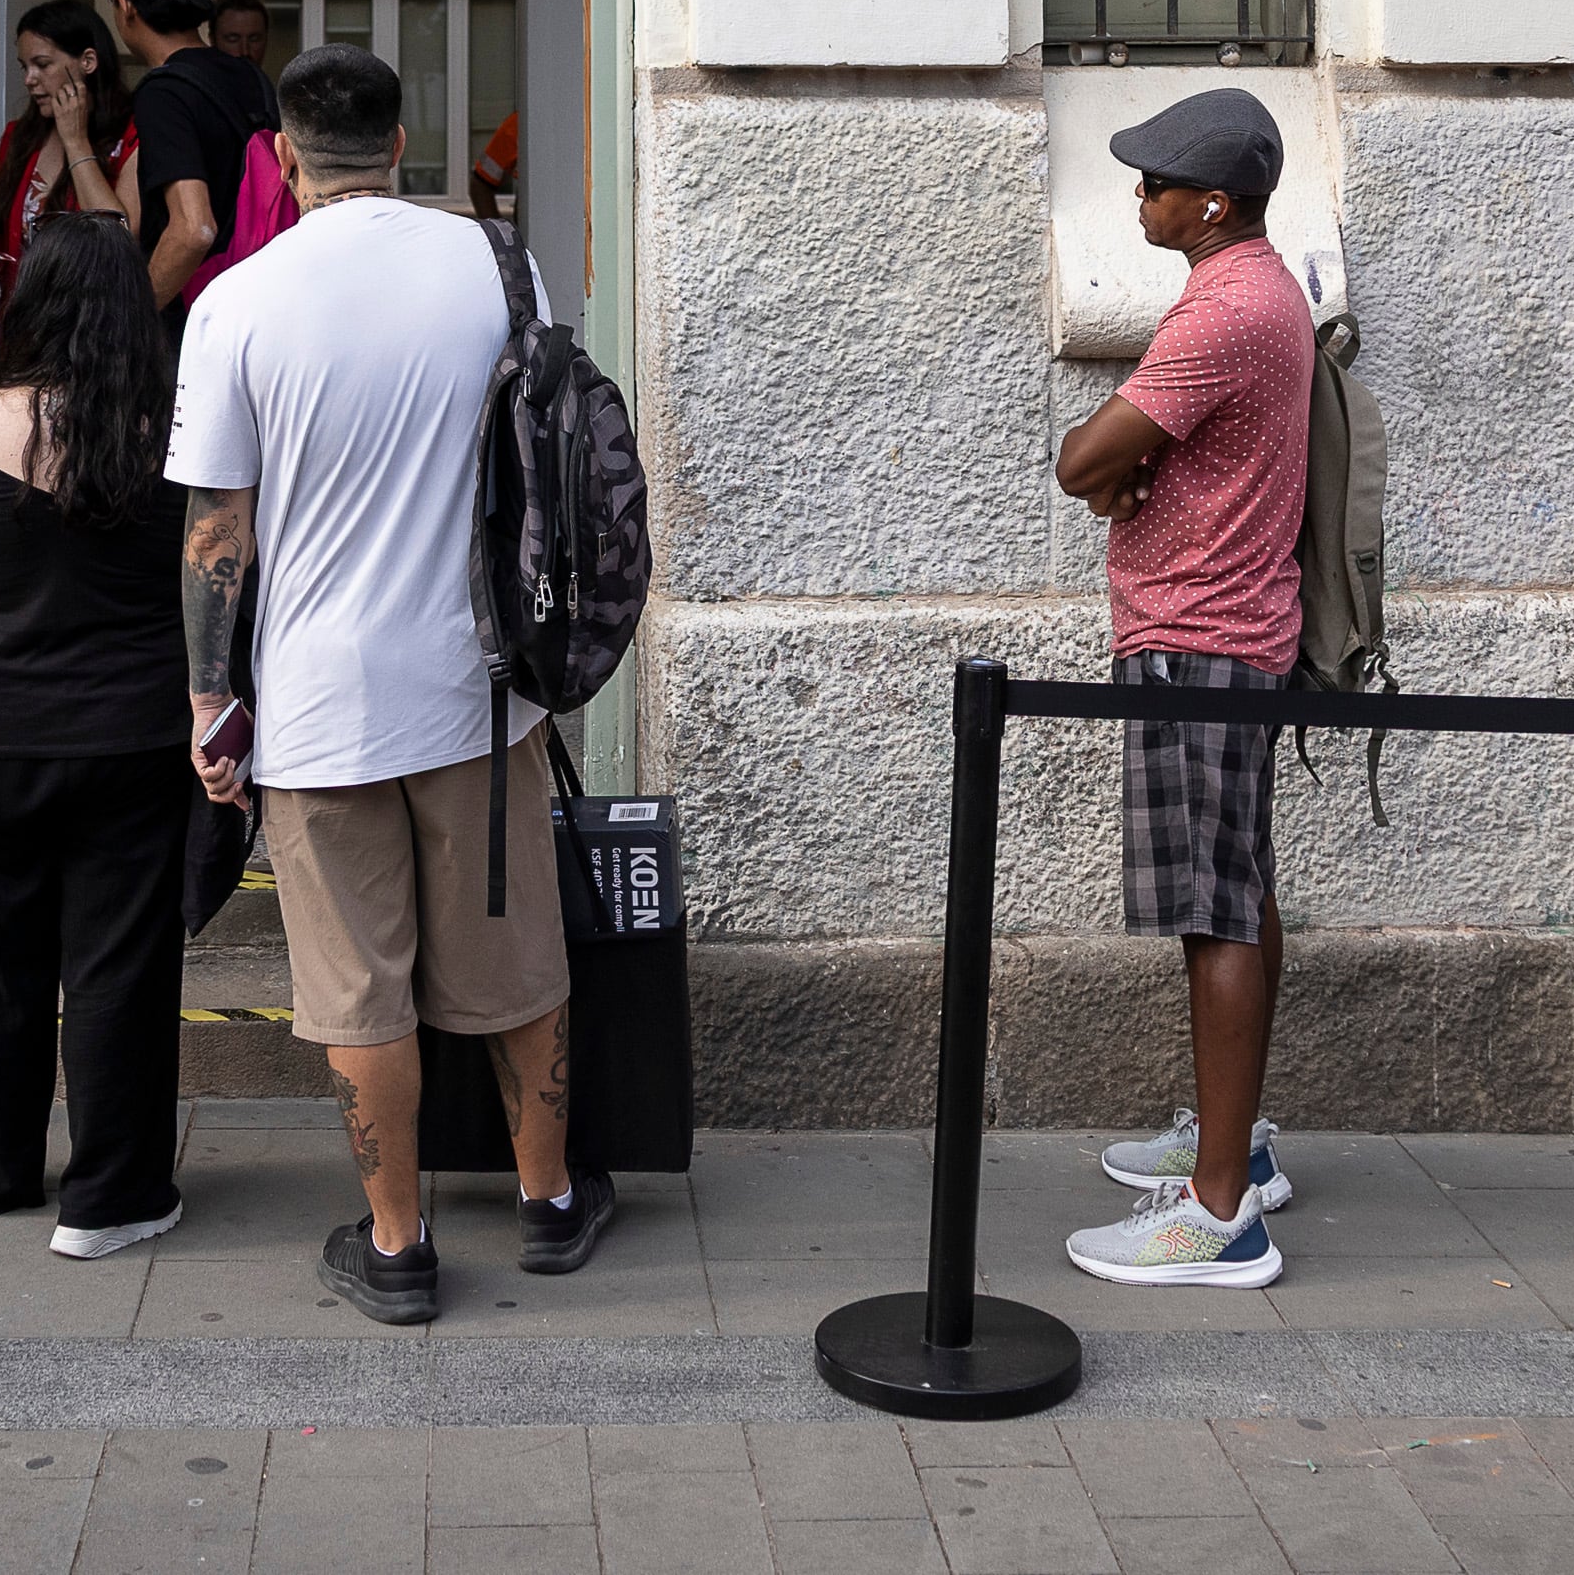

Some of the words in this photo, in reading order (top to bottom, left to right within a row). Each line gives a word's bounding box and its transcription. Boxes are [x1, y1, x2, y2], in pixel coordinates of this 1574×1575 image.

[591, 848, 602, 866] KSF
[612, 847, 621, 863] Get
[612, 864, 623, 889] ready
[614, 890, 624, 903] for
